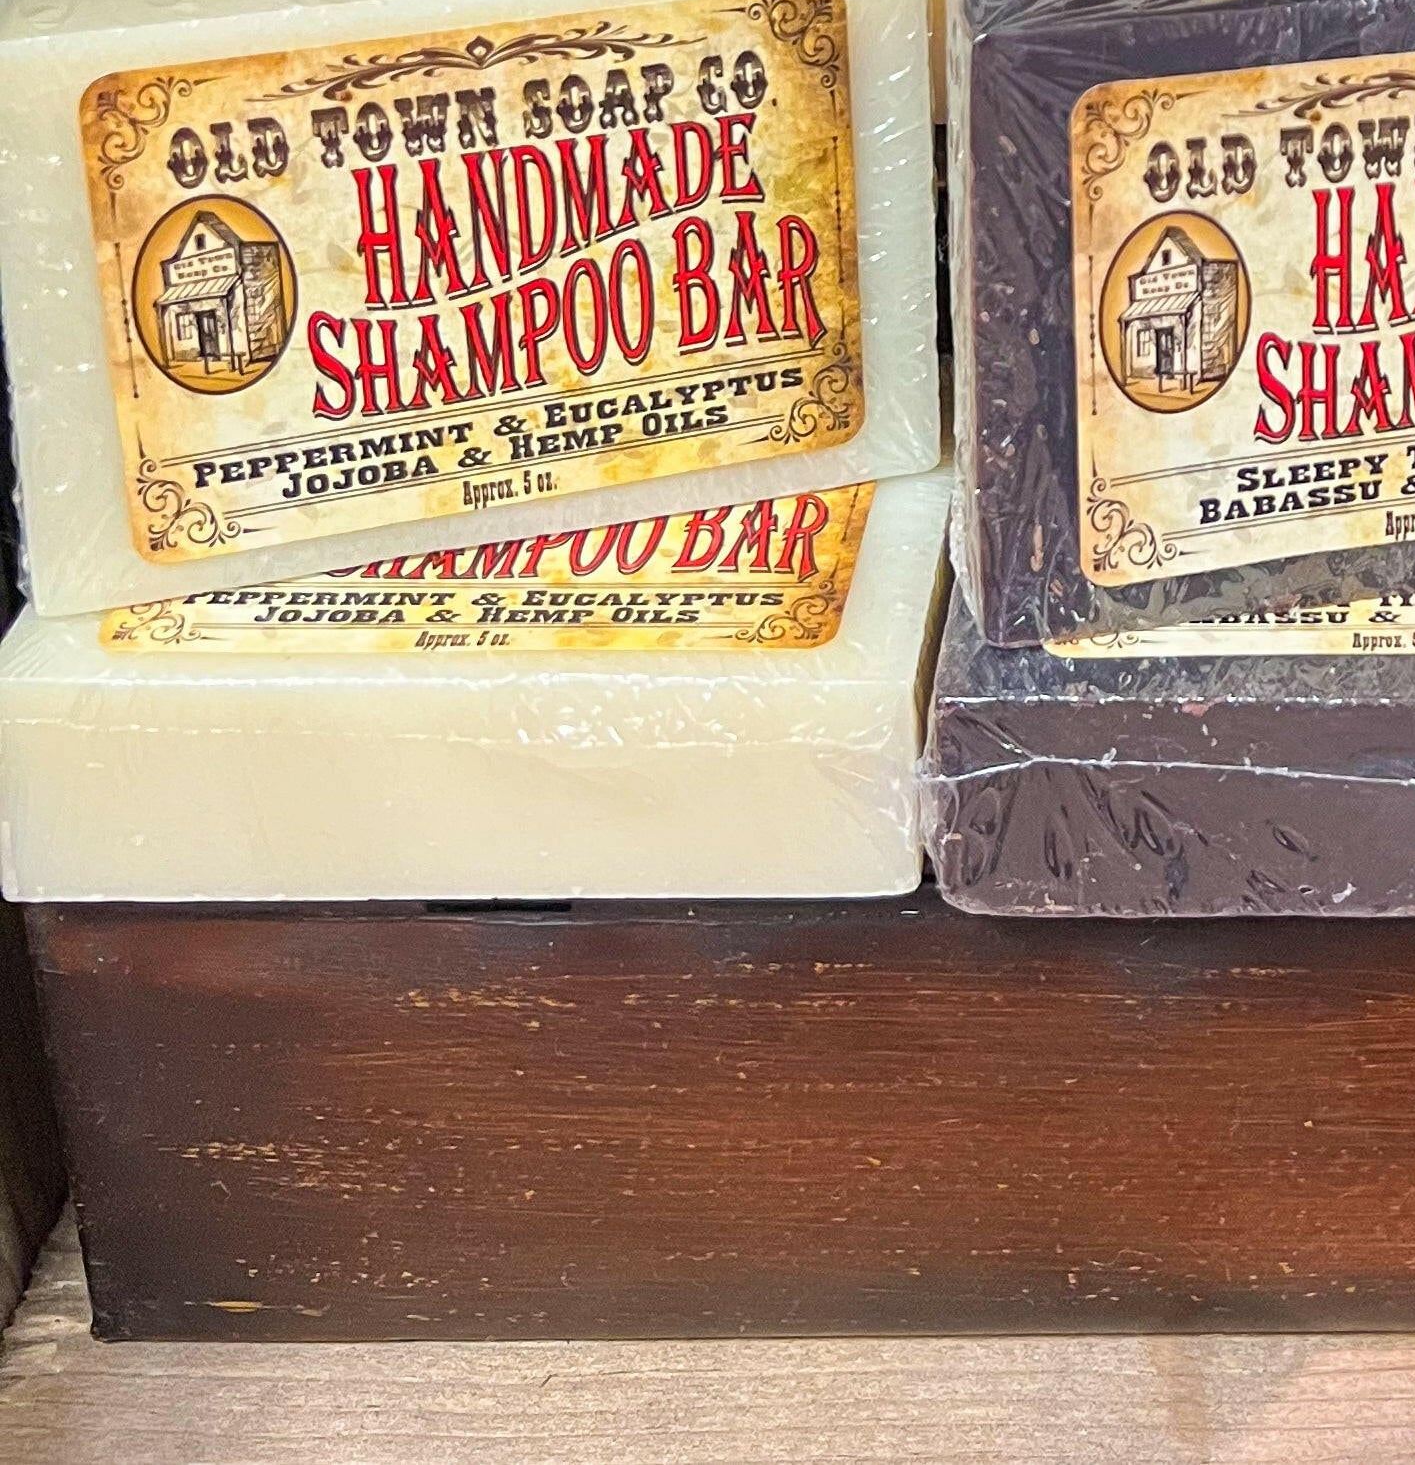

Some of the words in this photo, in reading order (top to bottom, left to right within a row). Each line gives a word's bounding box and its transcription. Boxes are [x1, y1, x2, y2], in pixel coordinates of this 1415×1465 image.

[168, 124, 291, 189] OLD
[311, 87, 500, 169] TOWN
[523, 62, 675, 138] SOAP
[697, 49, 778, 118] CO.
[1143, 140, 1258, 205] OLD
[351, 113, 765, 314] HANDMADE
[308, 244, 655, 422] SHAMPOO
[671, 212, 827, 357] BAR
[192, 422, 474, 489] PEPPERMINT
[496, 412, 529, 438] &
[544, 365, 806, 428] EUCALYPTUS
[280, 458, 439, 501] JOJOBA
[457, 442, 492, 469] &
[508, 420, 626, 463] HEMP
[641, 403, 730, 438] OILS
[462, 478, 519, 510] Approx.
[523, 469, 532, 495] 5
[537, 471, 558, 493] oz.
[1234, 451, 1391, 495] SLEEPY
[1198, 480, 1382, 527] BABASSU
[671, 493, 829, 582] BAR
[254, 605, 407, 624] JOJOBA
[425, 609, 462, 624] &
[477, 606, 595, 624] HEMP
[611, 606, 700, 623] OILS
[471, 591, 506, 606] &
[522, 590, 784, 606] EUCALYPTUS
[1368, 610, 1401, 623] &
[1352, 632, 1407, 651] Approx.
